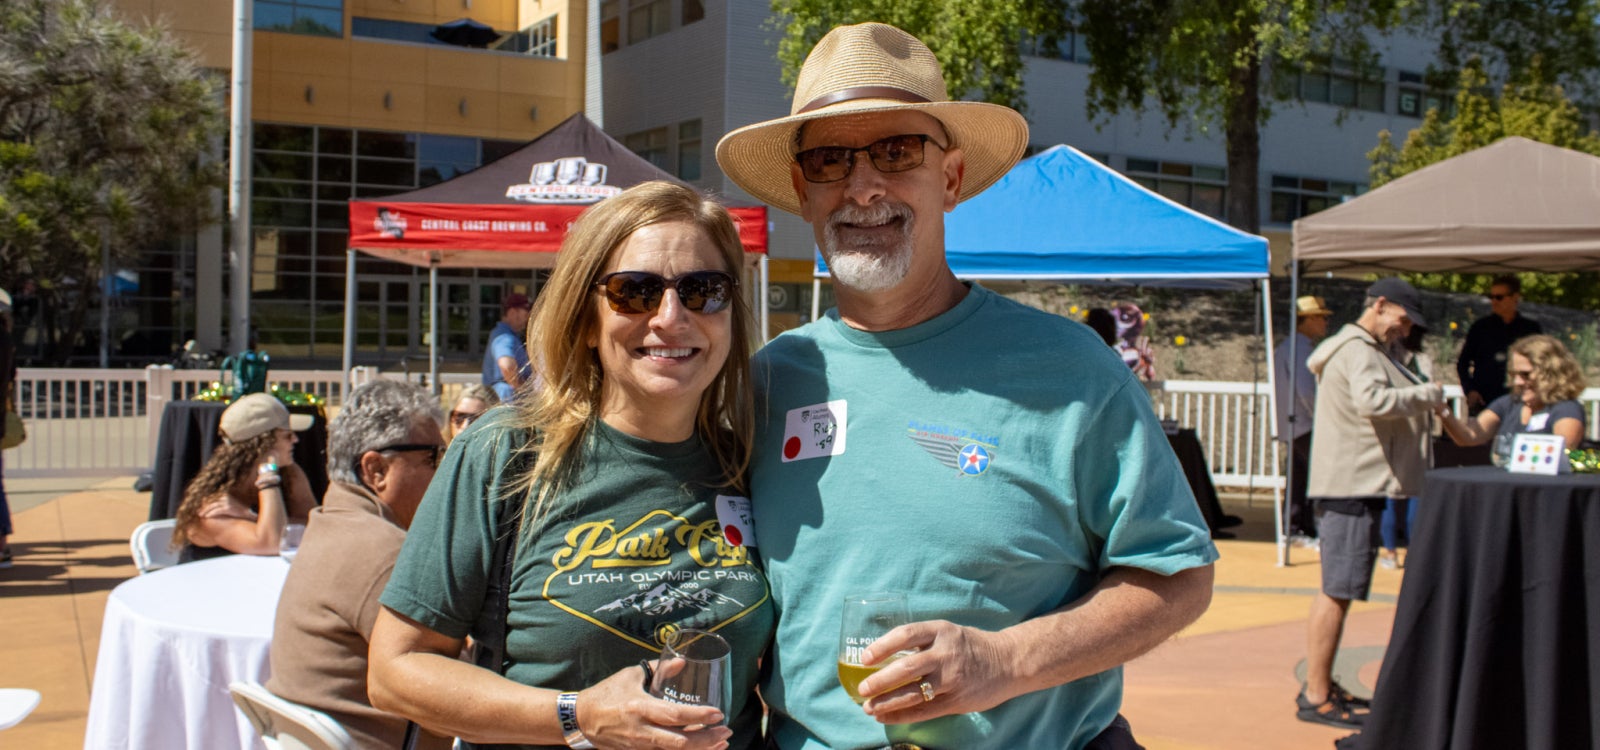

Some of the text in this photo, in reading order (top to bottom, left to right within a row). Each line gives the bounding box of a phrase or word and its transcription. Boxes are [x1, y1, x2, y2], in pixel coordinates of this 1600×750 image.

[511, 184, 569, 194] CENTRAL
[421, 219, 549, 232] CENTRAL COAST BREWING CO.
[552, 518, 672, 570] Park
[568, 570, 759, 585] UTAH OLYMPIC PARK
[846, 637, 858, 645] CAL
[664, 687, 678, 698] CAL
[680, 693, 701, 702] POLY
